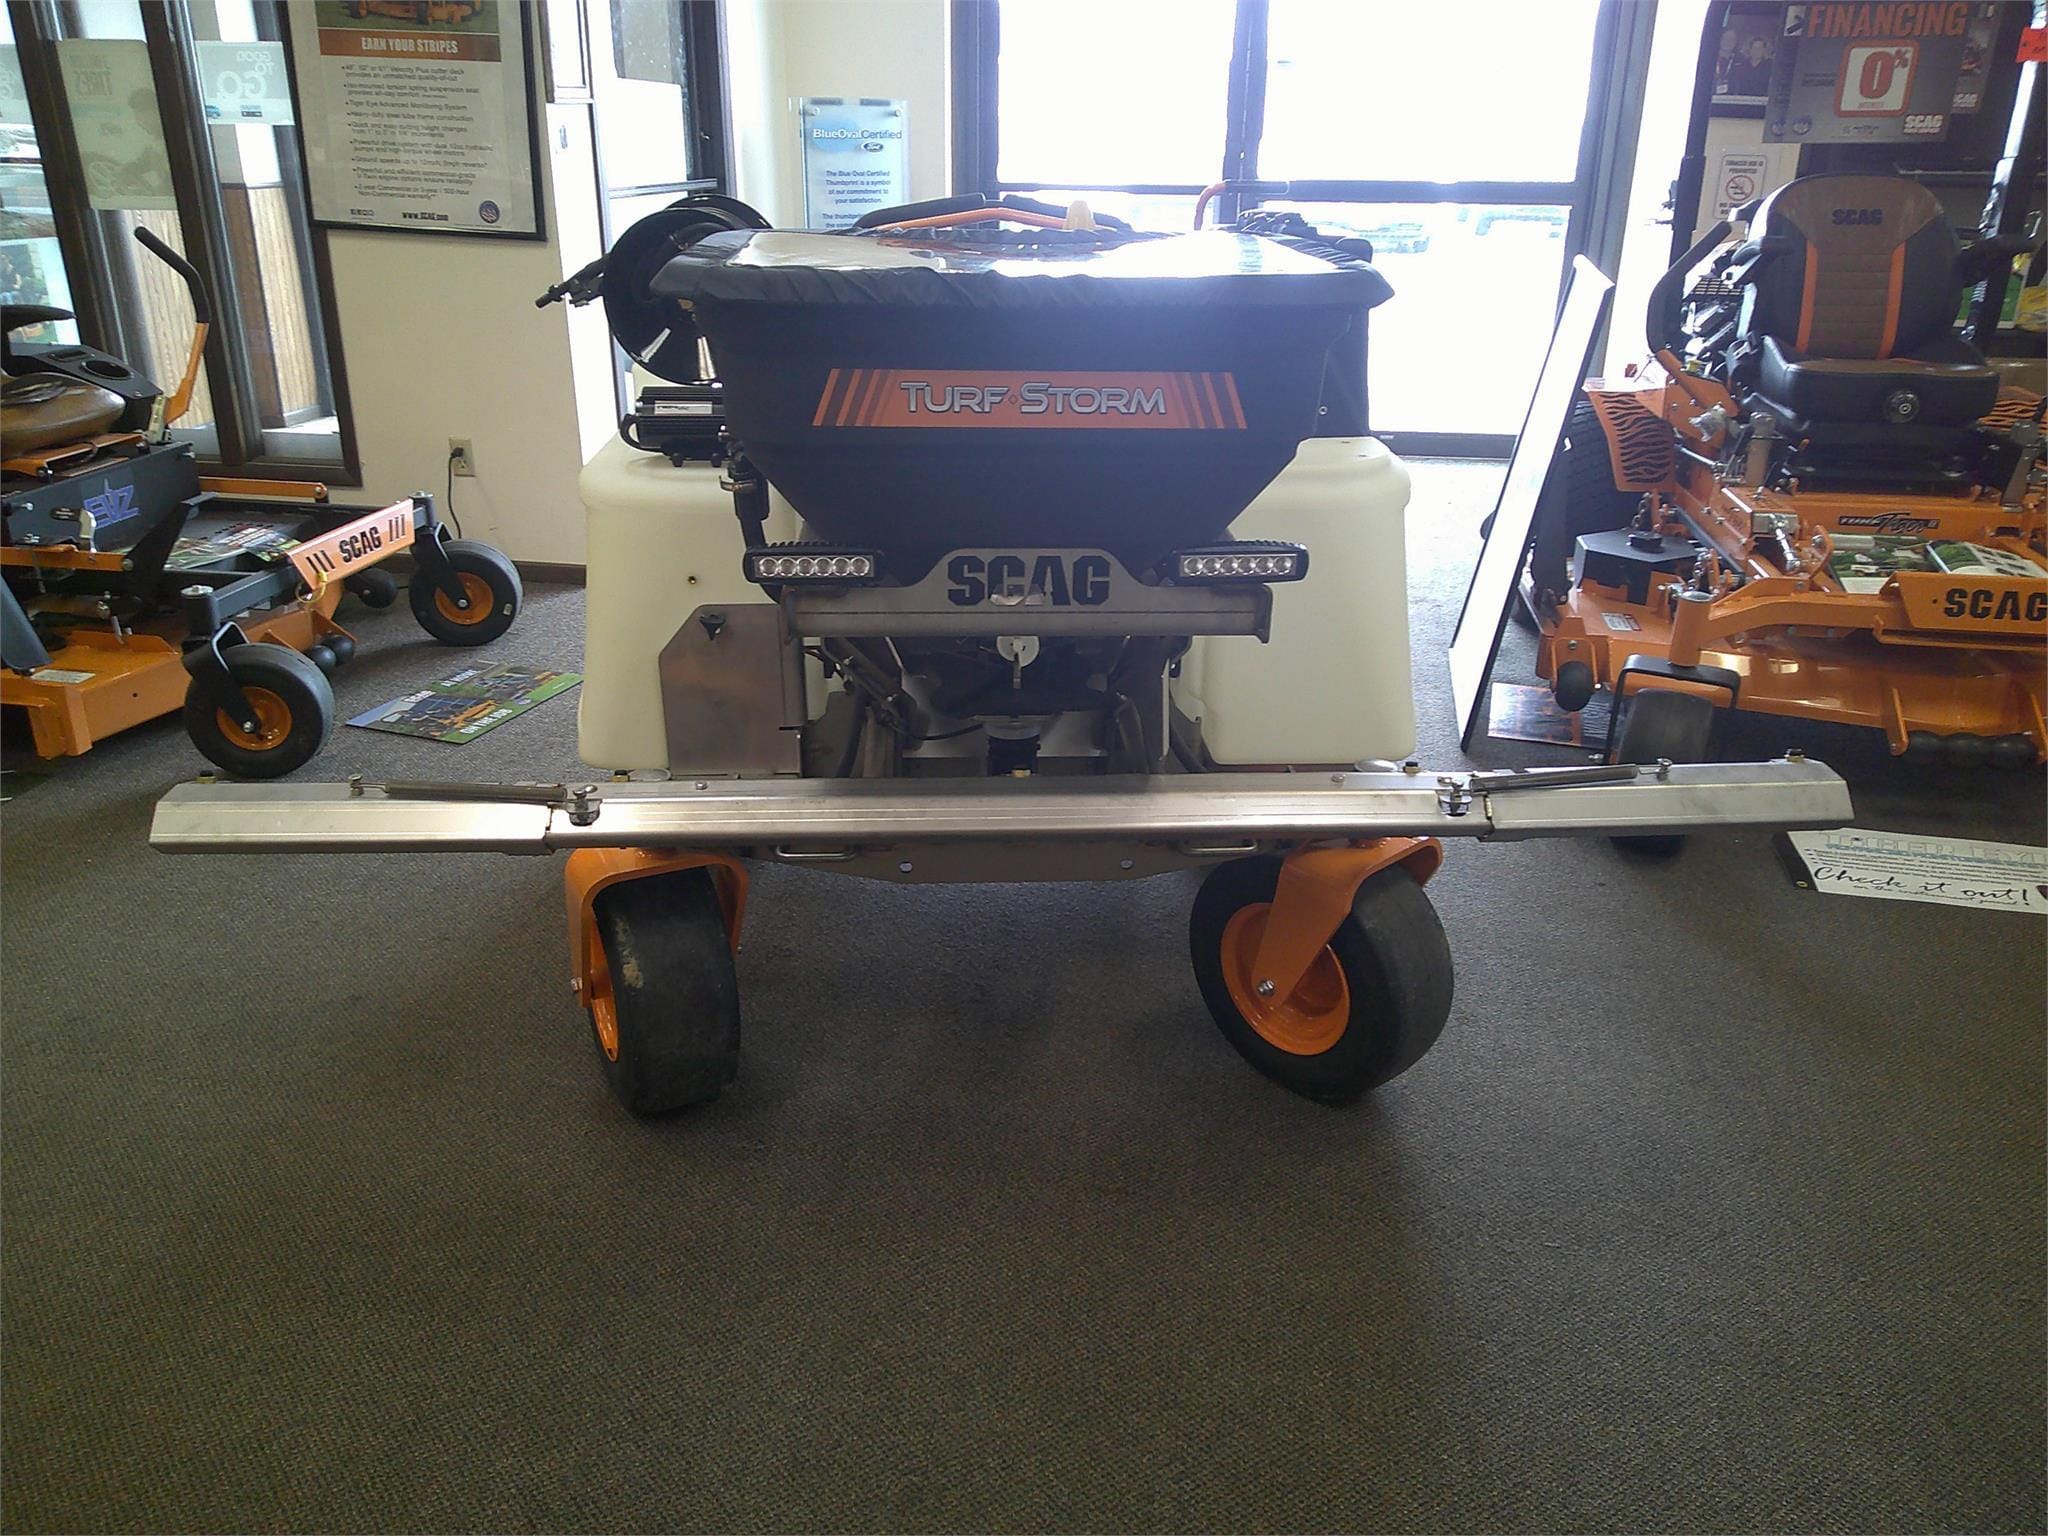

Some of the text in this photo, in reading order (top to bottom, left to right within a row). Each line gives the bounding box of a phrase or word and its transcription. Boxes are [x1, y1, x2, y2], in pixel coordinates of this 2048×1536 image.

[1807, 1, 1970, 38] FINANCING
[361, 37, 459, 54] EARN YOUR STRIPES
[1831, 208, 1884, 226] SCAG
[900, 380, 1168, 415] TURF STORM
[338, 526, 383, 563] SCAG
[947, 555, 1111, 606] SCAG
[1943, 587, 2048, 622] SCAG
[1813, 866, 1908, 888] Check
[1919, 881, 1952, 894] it
[1960, 887, 2031, 906] out!
